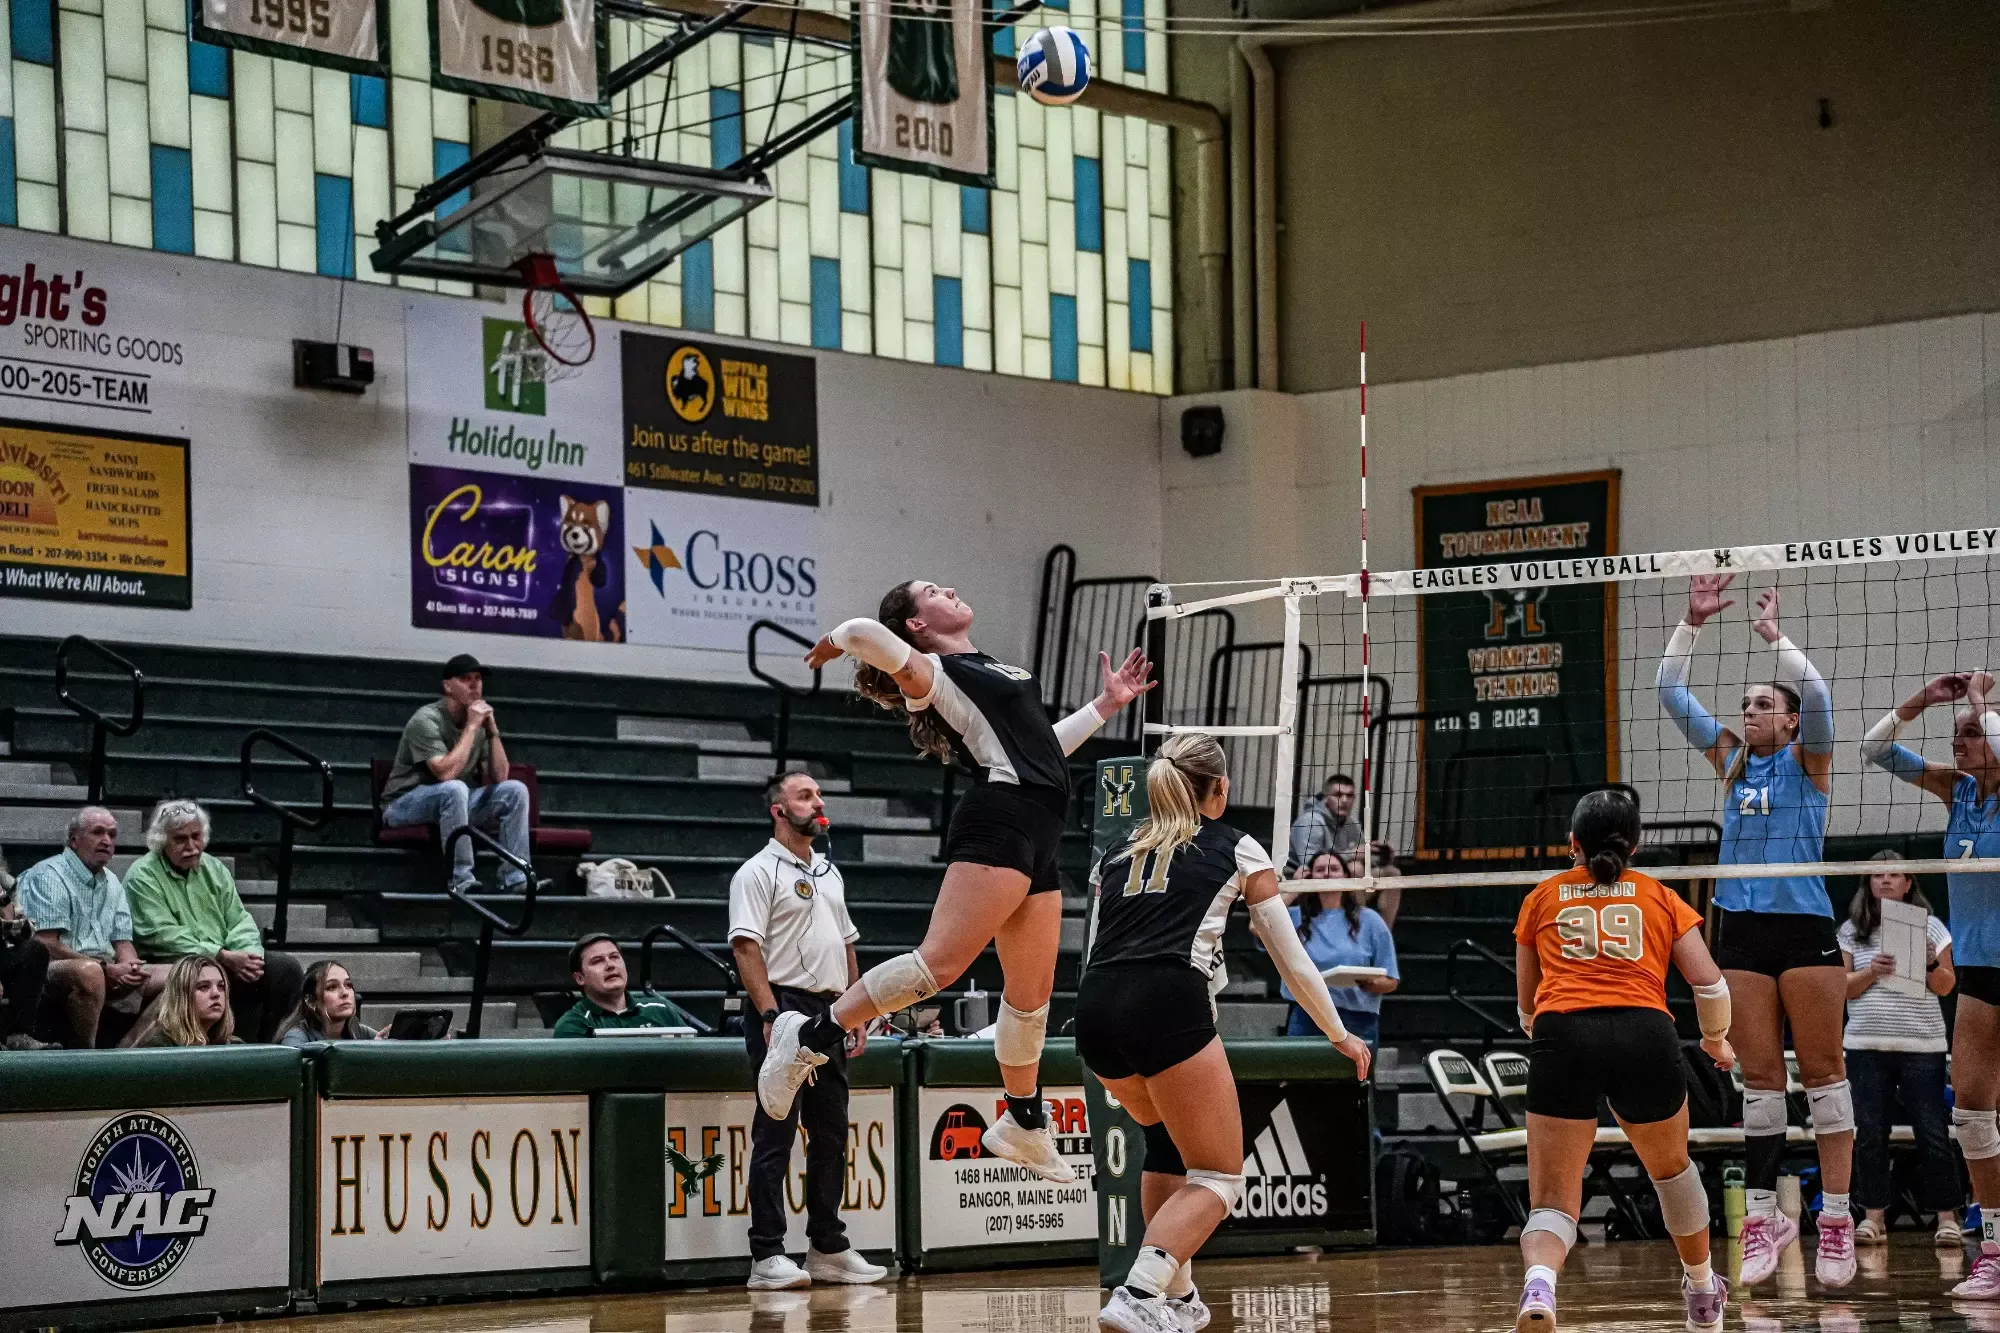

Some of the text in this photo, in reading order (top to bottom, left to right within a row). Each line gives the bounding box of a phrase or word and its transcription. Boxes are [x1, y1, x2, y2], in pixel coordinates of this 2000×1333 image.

[895, 114, 953, 157] 2010
[0, 263, 107, 326] ght's
[24, 323, 183, 366] SPORTING GOODS
[1, 365, 148, 404] 00-205-TEAM
[723, 375, 768, 401] WILD
[722, 396, 769, 422] WINGS
[448, 417, 585, 470] Holiday Inn
[631, 423, 812, 468] Join us after the game!
[422, 484, 537, 573] Caron
[1486, 497, 1543, 527] NCAA
[1440, 521, 1590, 559] TOURNAMENT
[1785, 529, 1998, 563] EAGLES VOLLEY
[445, 569, 519, 587] SIGNS
[685, 529, 817, 598] CROSS
[1412, 554, 1662, 589] EAGLES VOLLEYBALL
[6, 568, 146, 596] What We're All About.
[694, 594, 816, 613] INSURANCE
[1467, 643, 1563, 673] WOMENS
[1474, 672, 1560, 702] TENNIS
[1493, 707, 1540, 728] 2023
[1738, 785, 1771, 816] 21
[1559, 882, 1636, 901] HUSSON
[1556, 903, 1643, 961] 99
[82, 1118, 195, 1184] NORTH ATLANTIC
[331, 1127, 581, 1236] HUSSON
[954, 1168, 980, 1185] 1468
[959, 1188, 1087, 1209] BANGOR, MAINE 04401
[1231, 1175, 1328, 1218] adidas
[54, 1188, 214, 1244] NAC
[985, 1212, 1064, 1235] (207) 945-5965
[91, 1240, 185, 1282] CONFERENCE
